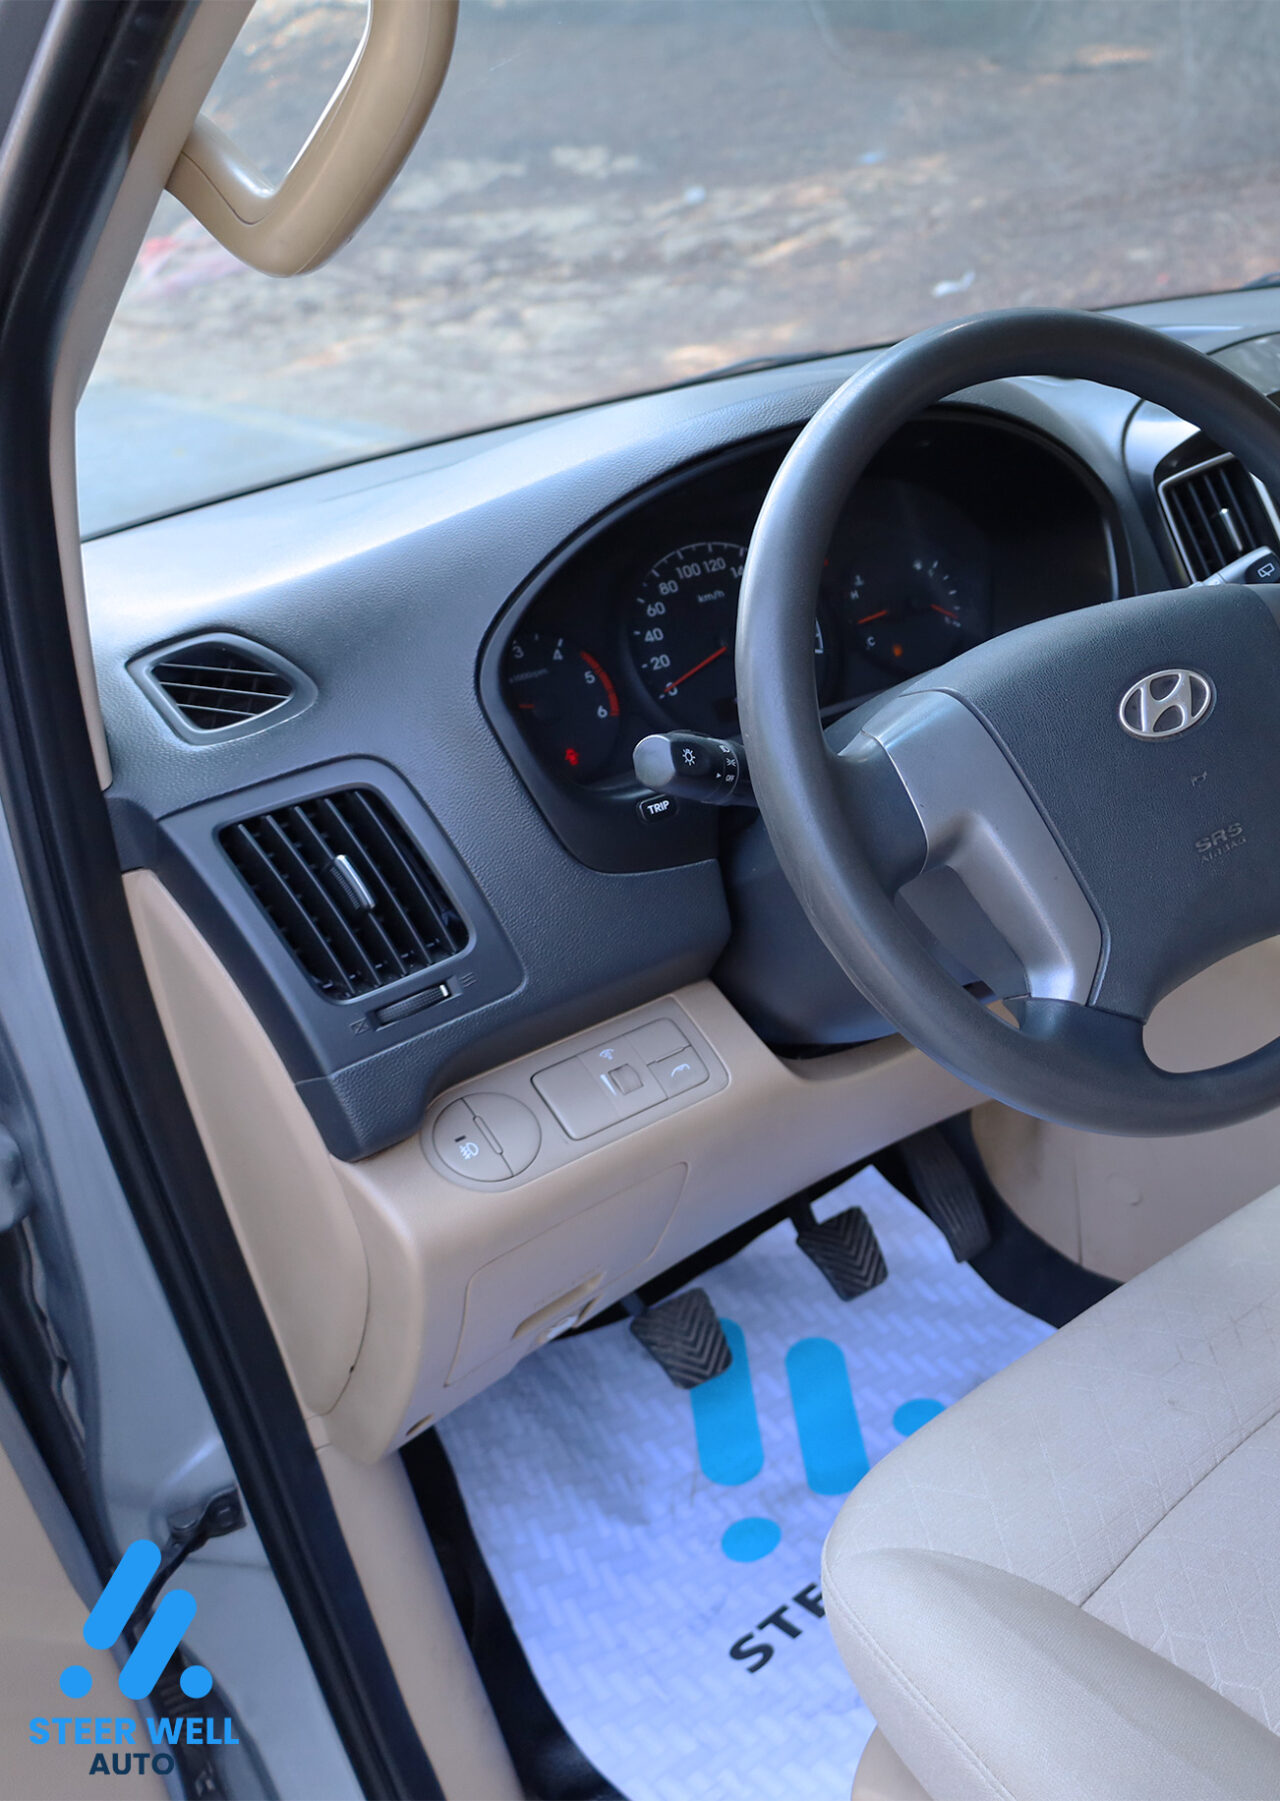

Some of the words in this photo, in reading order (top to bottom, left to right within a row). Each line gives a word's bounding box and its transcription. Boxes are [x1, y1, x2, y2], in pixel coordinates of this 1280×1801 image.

[675, 563, 701, 579] 100
[703, 557, 726, 573] 120
[730, 565, 744, 579] 14
[658, 580, 678, 595] 80
[698, 589, 725, 602] km/h
[646, 602, 666, 617] 60
[644, 628, 664, 642] 40
[512, 646, 524, 658] 3
[553, 649, 563, 660] 4
[651, 654, 671, 670] 20
[584, 671, 595, 684] 5
[597, 705, 608, 718] 6
[647, 800, 670, 815] TRIP
[1195, 822, 1243, 853] SRS
[729, 1582, 827, 1675] STE
